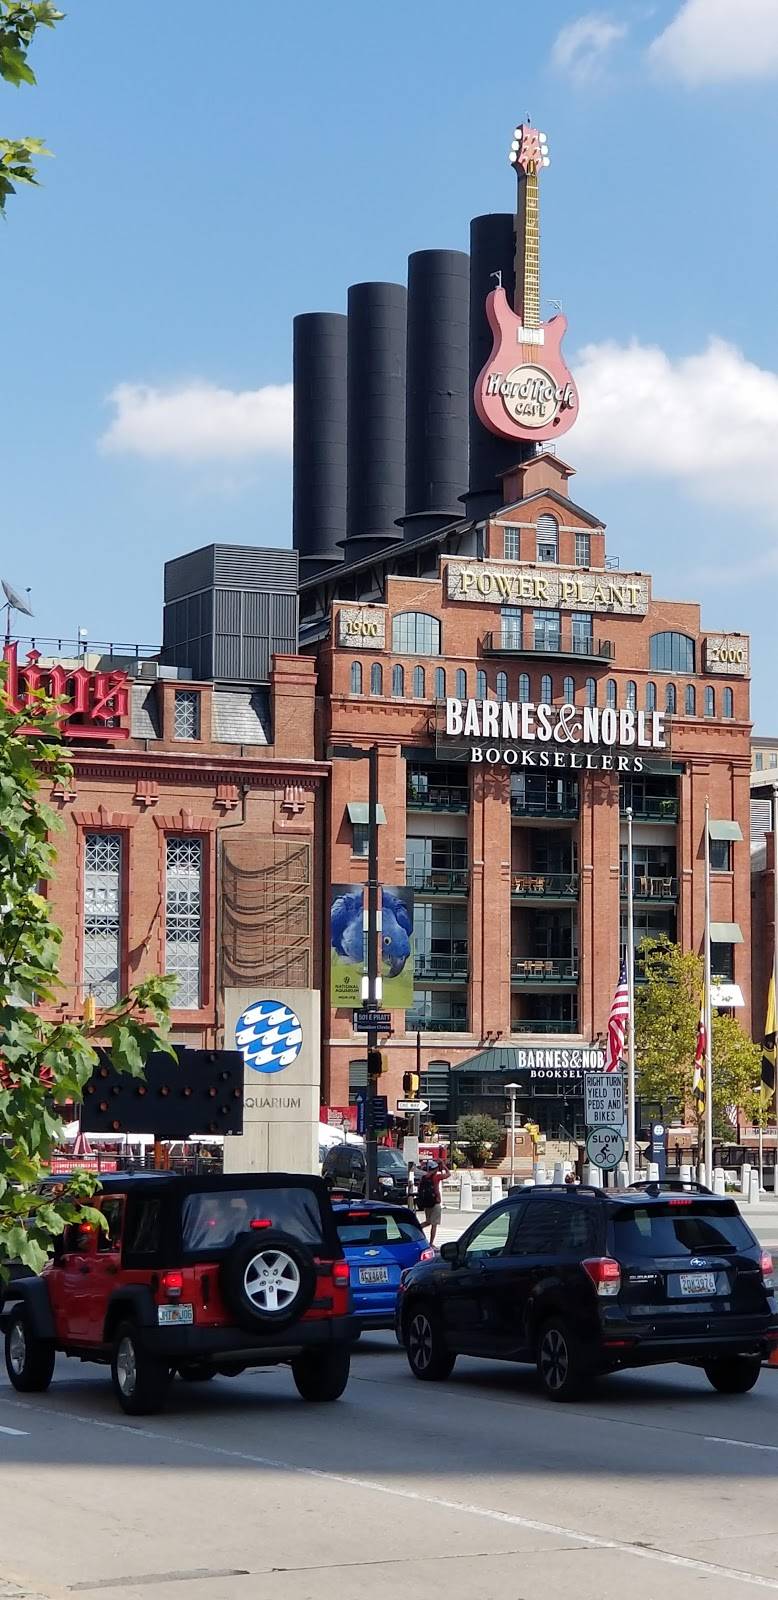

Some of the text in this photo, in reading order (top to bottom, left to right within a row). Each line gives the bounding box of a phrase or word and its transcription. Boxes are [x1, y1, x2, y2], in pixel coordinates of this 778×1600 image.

[486, 373, 575, 409] Hard Rock
[458, 570, 640, 608] POWER PLANT
[346, 621, 378, 637] 1900
[710, 647, 743, 663] 2000
[446, 698, 666, 748] BARNES&NOBLE
[471, 746, 644, 772] BOOKSELLERS
[587, 1077, 621, 1087] RIGHT TURN
[587, 1088, 621, 1098] YIELD TO
[243, 1097, 301, 1109] QUARIUM
[588, 1100, 621, 1110] PEDS AND
[594, 1111, 616, 1121] BIKES
[592, 1135, 619, 1143] SLOW
